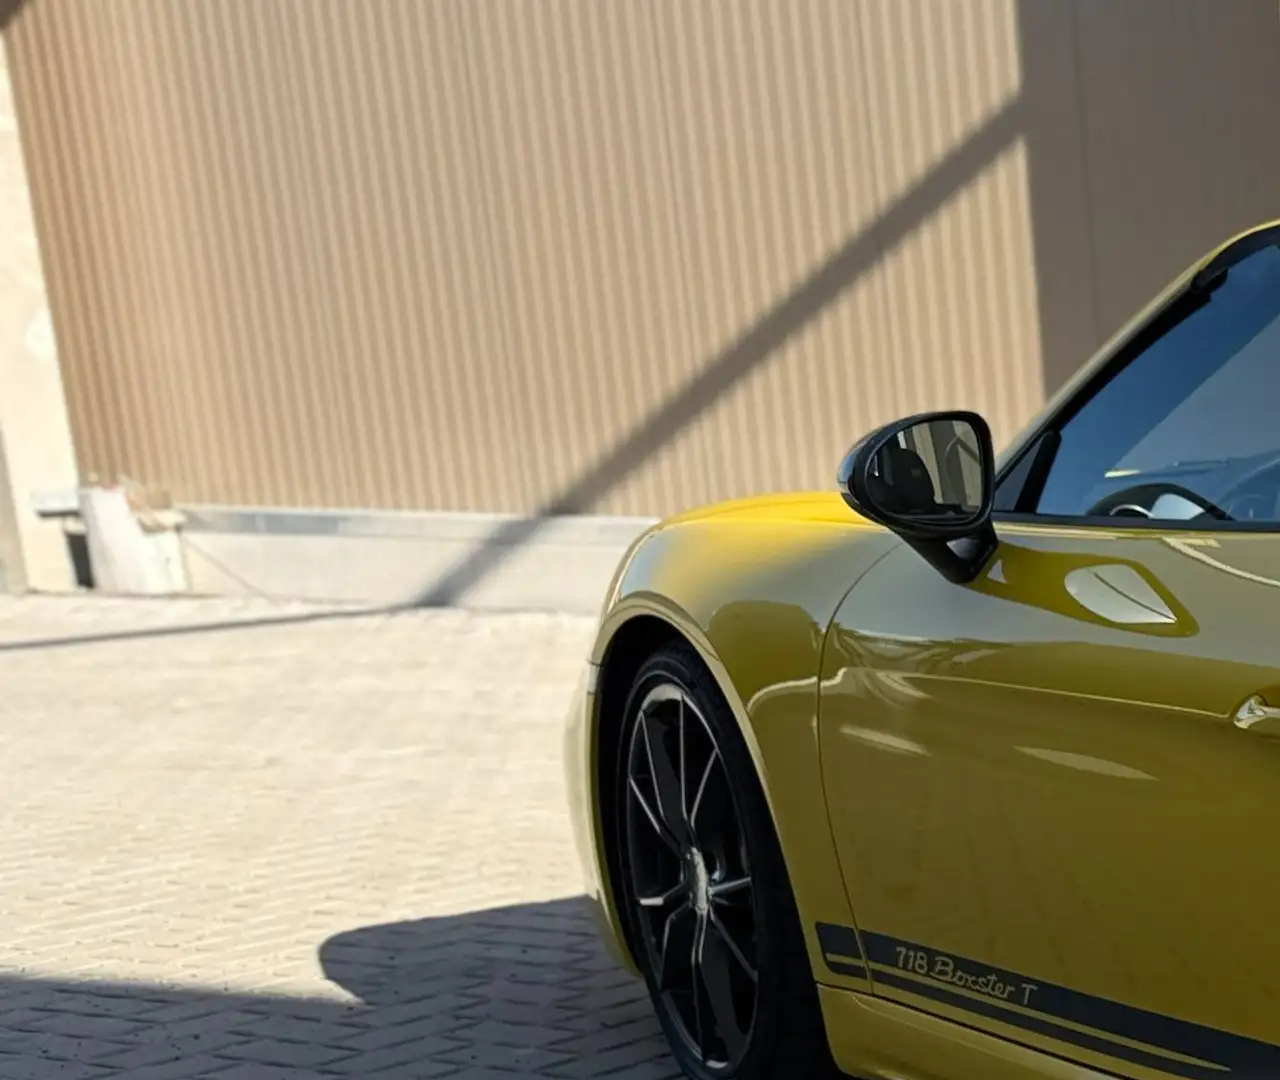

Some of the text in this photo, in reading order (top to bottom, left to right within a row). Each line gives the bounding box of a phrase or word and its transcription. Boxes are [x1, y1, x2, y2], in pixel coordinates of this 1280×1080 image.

[896, 946, 1039, 1005] 718 Boxster T
